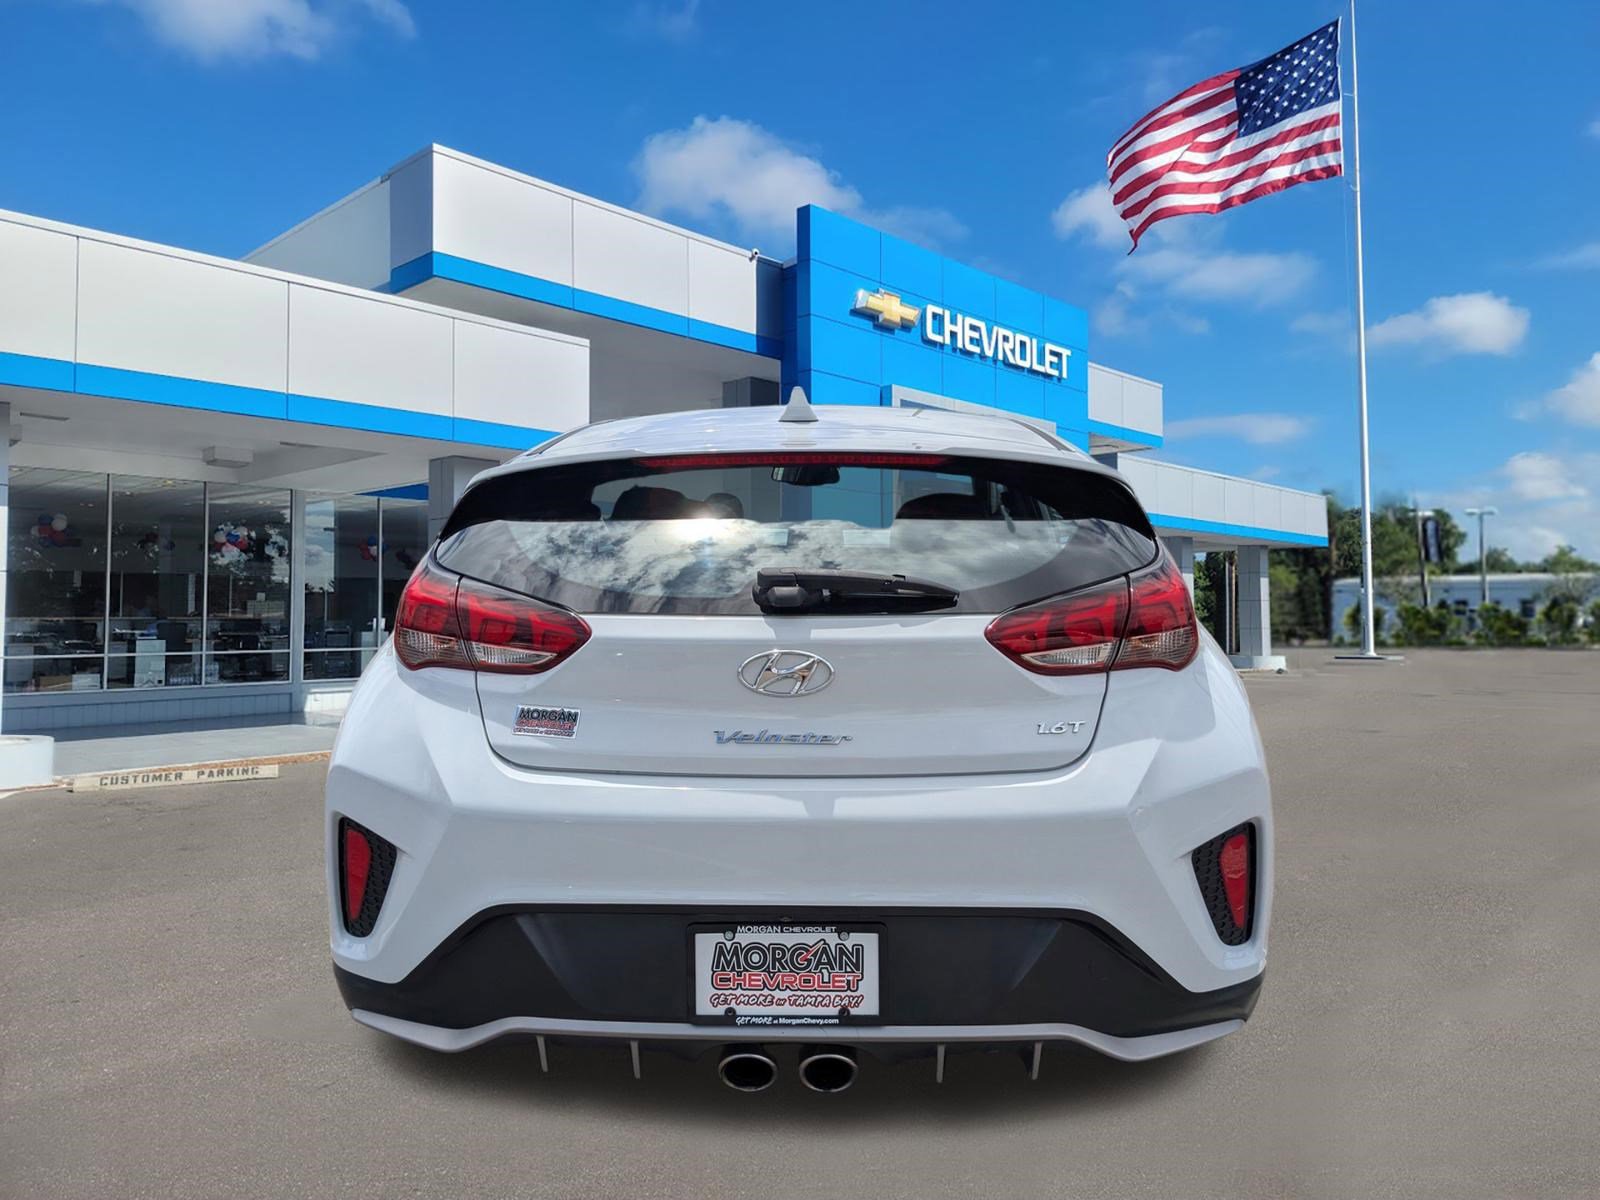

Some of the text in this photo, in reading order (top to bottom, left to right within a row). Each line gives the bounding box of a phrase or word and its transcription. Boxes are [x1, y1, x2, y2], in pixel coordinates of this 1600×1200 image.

[925, 303, 1072, 379] CHEVROLET
[519, 707, 579, 723] MORGAN
[100, 766, 259, 786] CUSTOMER PARKING
[736, 925, 781, 933] MORGAN
[712, 940, 864, 972] MORGAN
[712, 971, 864, 991] CHEVROLET
[711, 993, 737, 1008] GET
[738, 994, 775, 1007] MORE
[787, 994, 831, 1008] TAMPA
[832, 994, 864, 1009] BAY!
[736, 1017, 750, 1025] GET
[749, 1016, 773, 1024] MORE
[779, 1017, 839, 1025] MorganChevy.com
